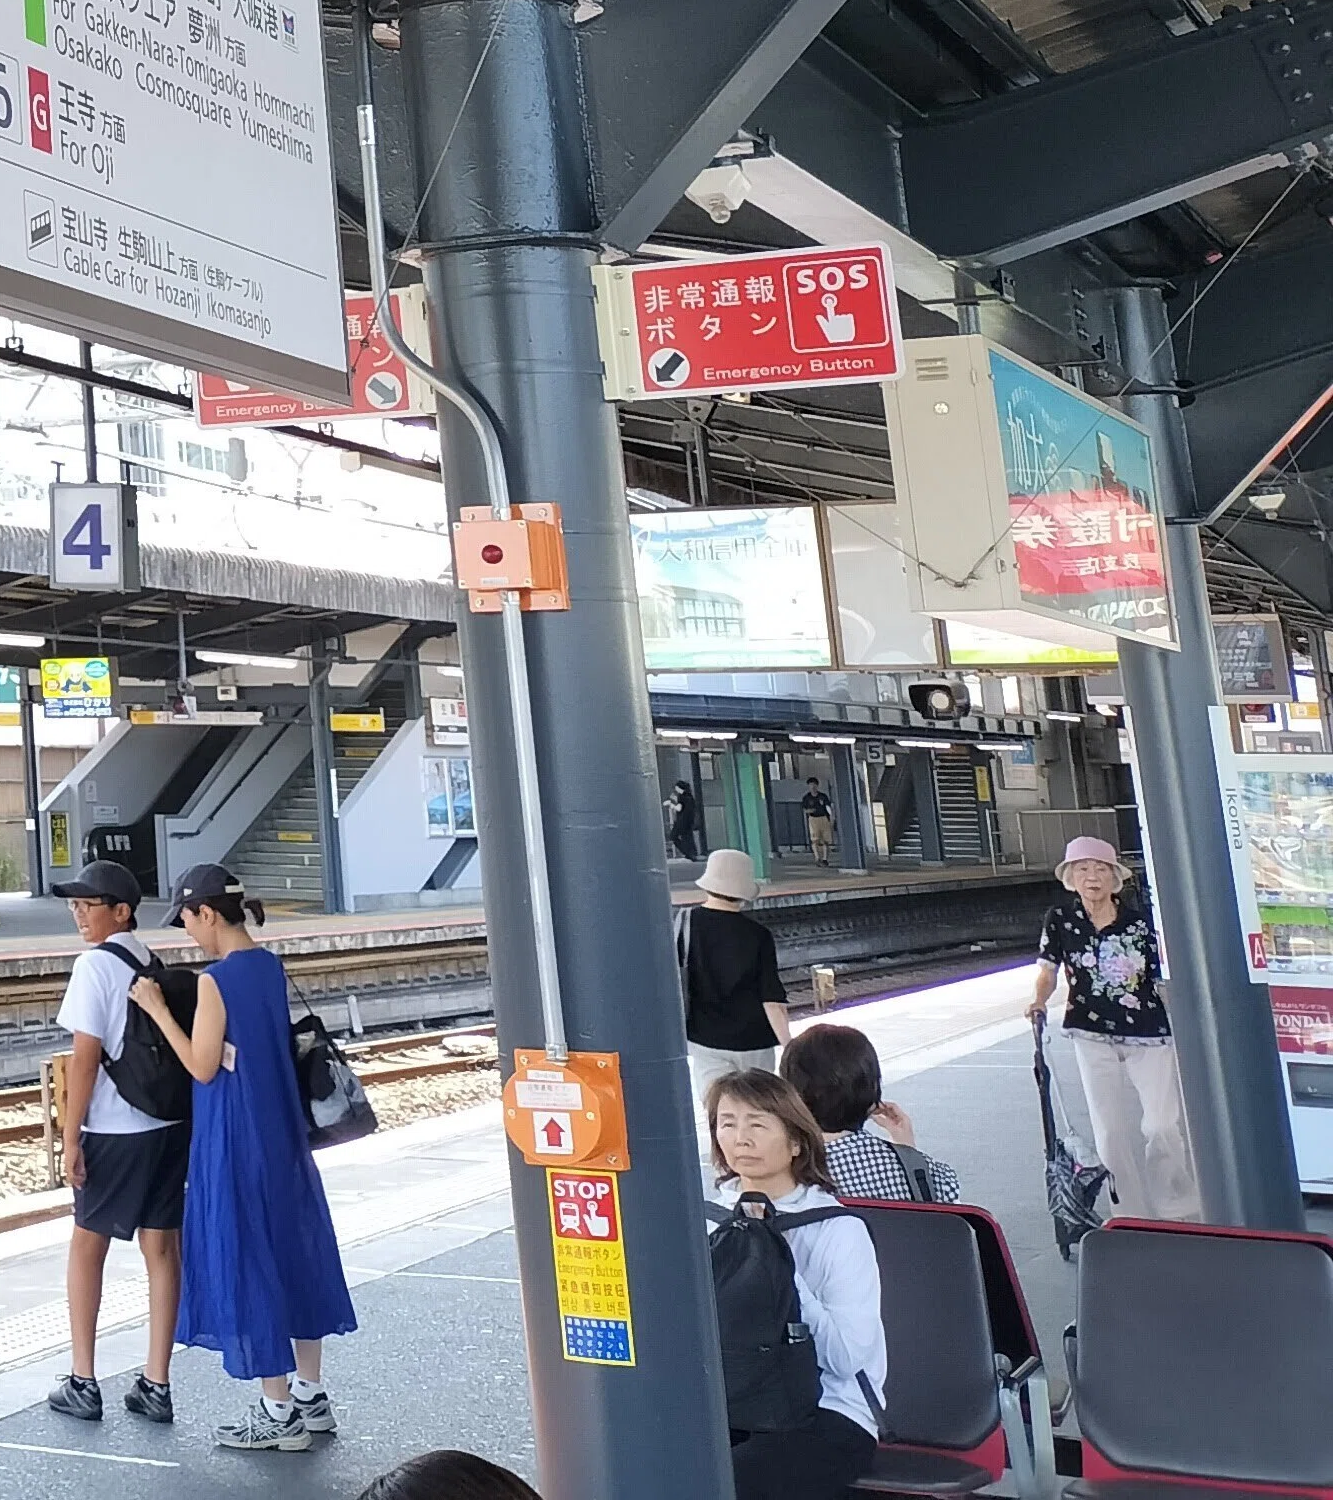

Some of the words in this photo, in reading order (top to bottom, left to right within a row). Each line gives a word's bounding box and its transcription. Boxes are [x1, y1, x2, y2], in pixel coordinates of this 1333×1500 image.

[85, 3, 247, 101] Gakken-Nara-Tomigaoka
[254, 80, 315, 133] Hommachi
[33, 93, 47, 131] G
[54, 25, 122, 80] Osakako
[136, 62, 231, 128] Cosmosquare
[238, 106, 313, 164] Yumeshima
[61, 129, 86, 167] For
[92, 143, 113, 184] Oji
[61, 206, 108, 251] 宝山寺
[63, 247, 101, 280] Cable
[105, 260, 127, 289] Car
[130, 266, 148, 295] for
[155, 276, 201, 318] Hozanji
[207, 292, 271, 339] Ikomasanjo
[643, 275, 777, 315] 非常通報
[796, 264, 869, 294] SOS
[646, 313, 777, 345] ボタン
[704, 361, 802, 381] Emergency
[810, 358, 875, 373] Button
[216, 402, 296, 418] Emergency
[62, 504, 111, 570] 4
[868, 745, 881, 761] 5
[1225, 787, 1243, 851] Ikoma
[554, 1179, 610, 1200] STOP
